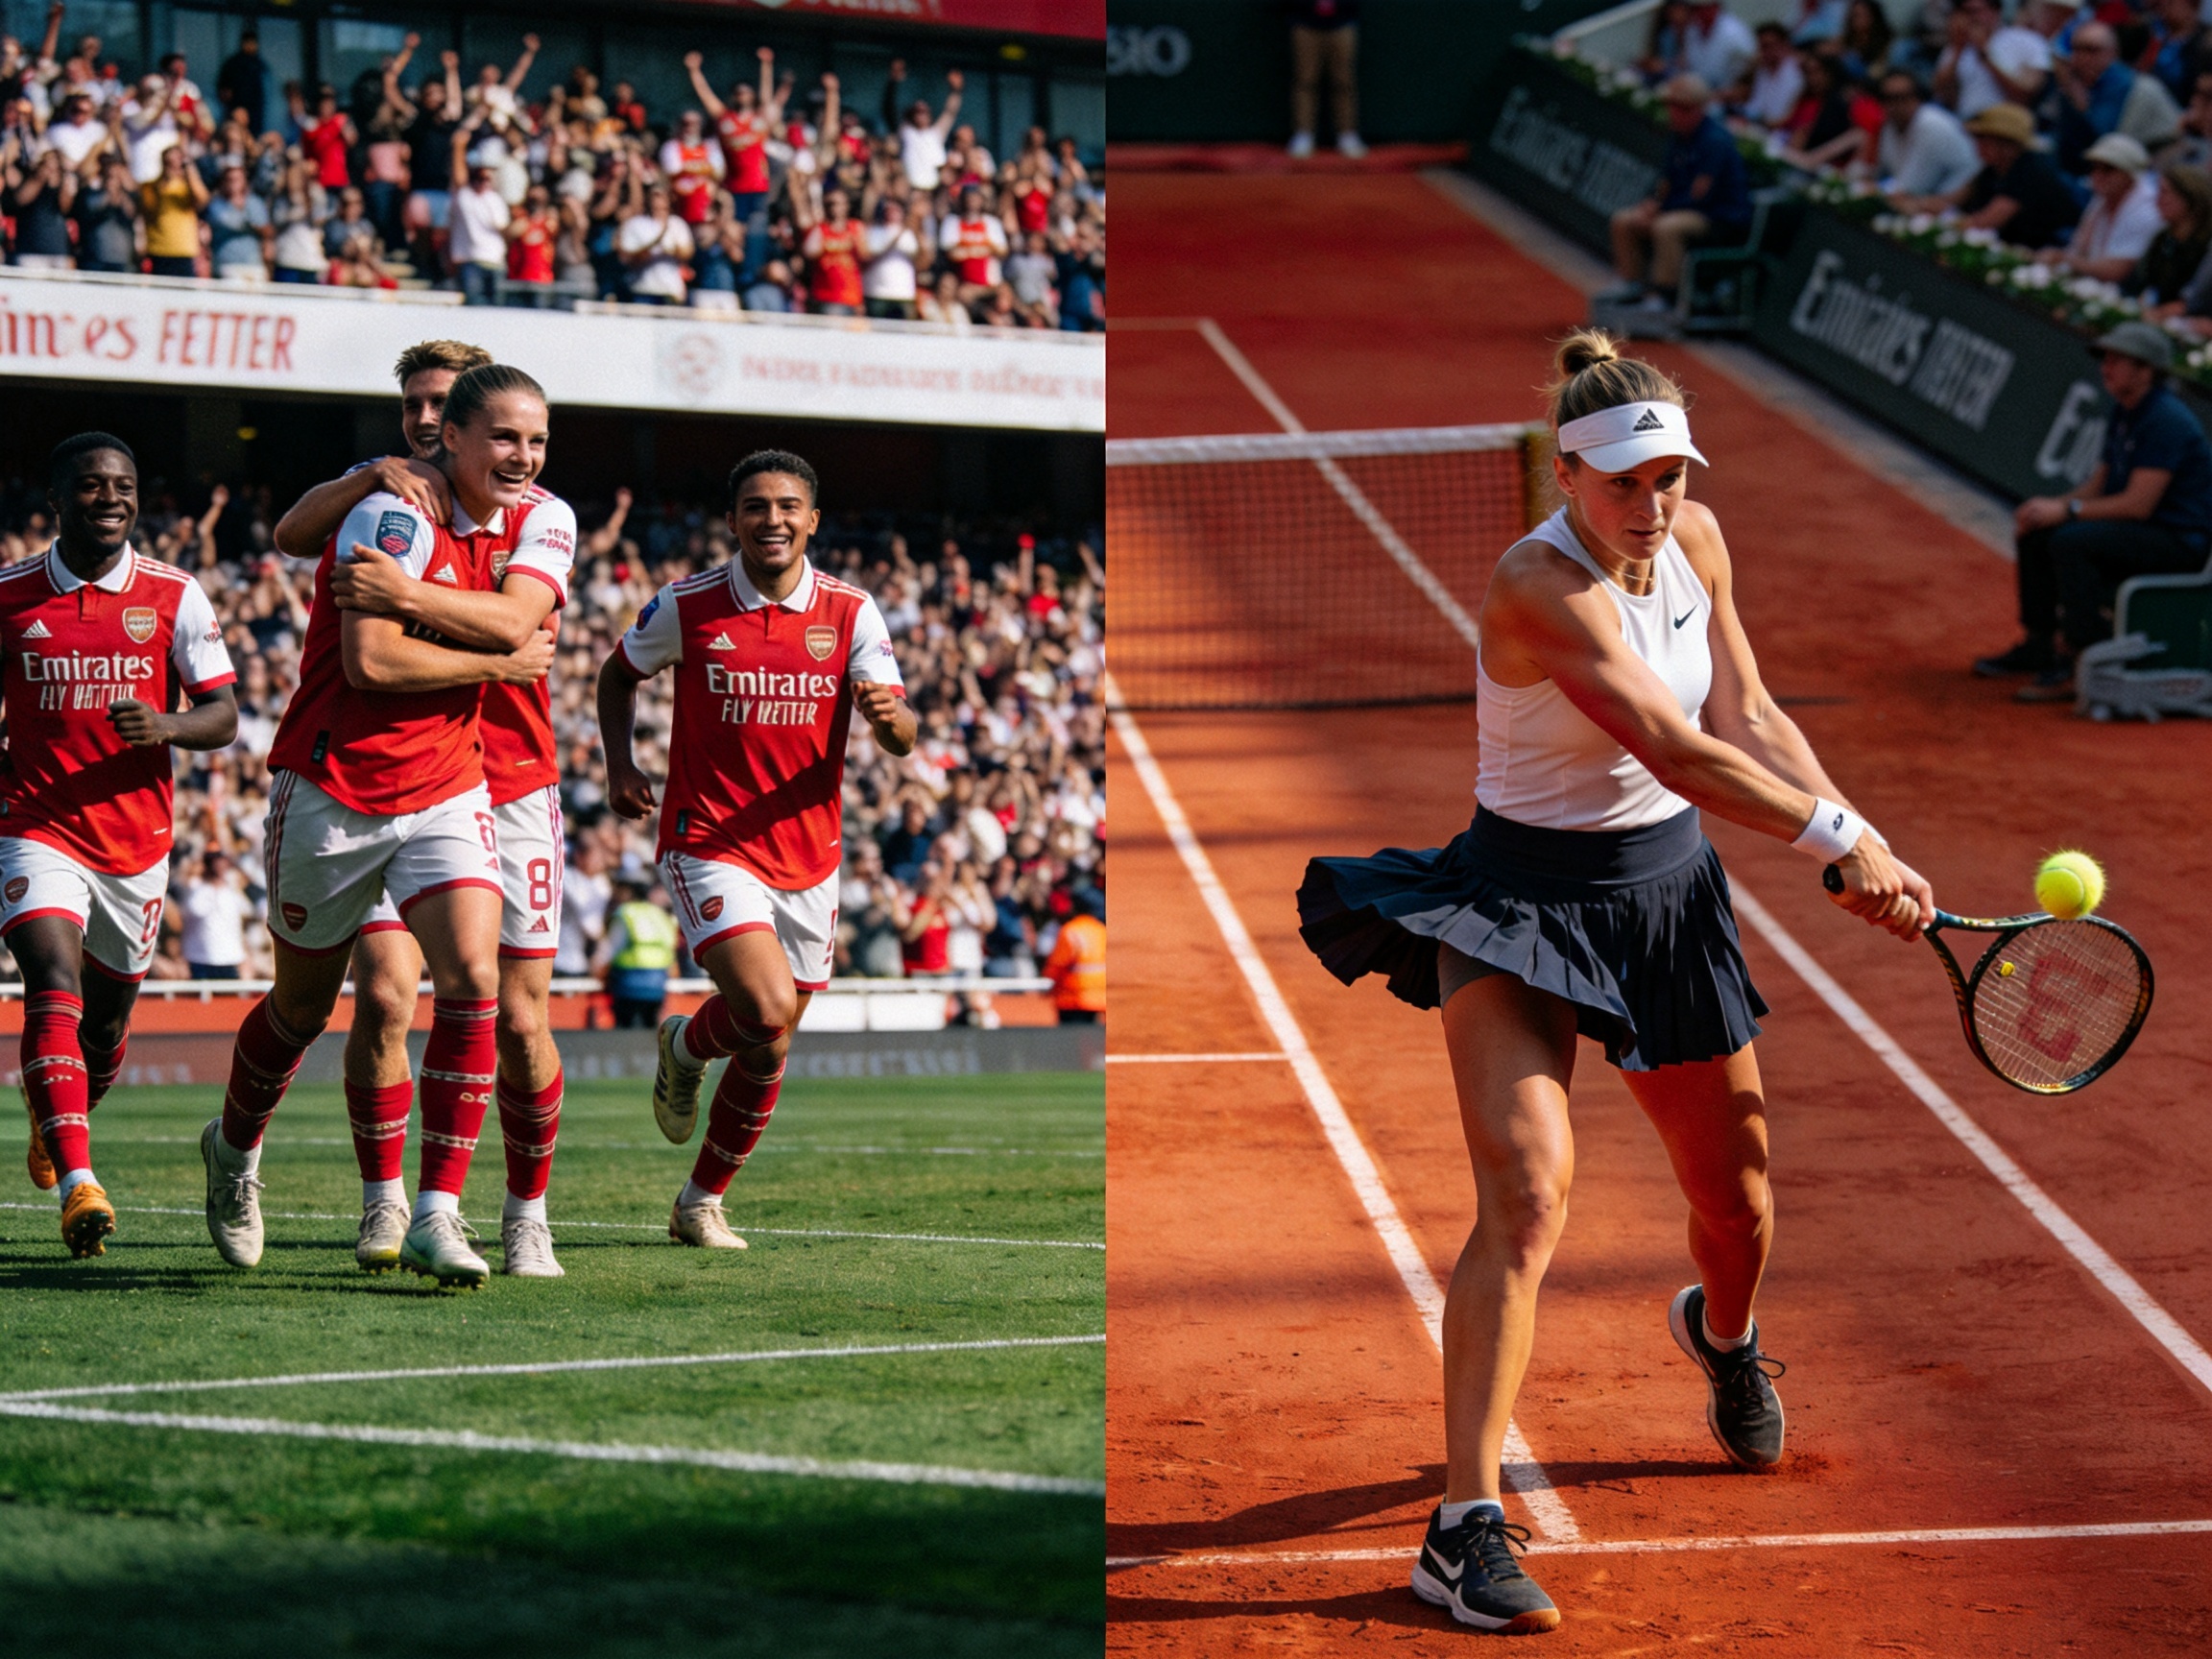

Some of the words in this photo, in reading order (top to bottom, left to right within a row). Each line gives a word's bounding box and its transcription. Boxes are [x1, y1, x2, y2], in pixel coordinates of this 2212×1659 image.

[157, 308, 298, 372] FETTER
[21, 650, 154, 682] Emirates
[706, 663, 837, 698] Emirates
[527, 858, 551, 910] 8
